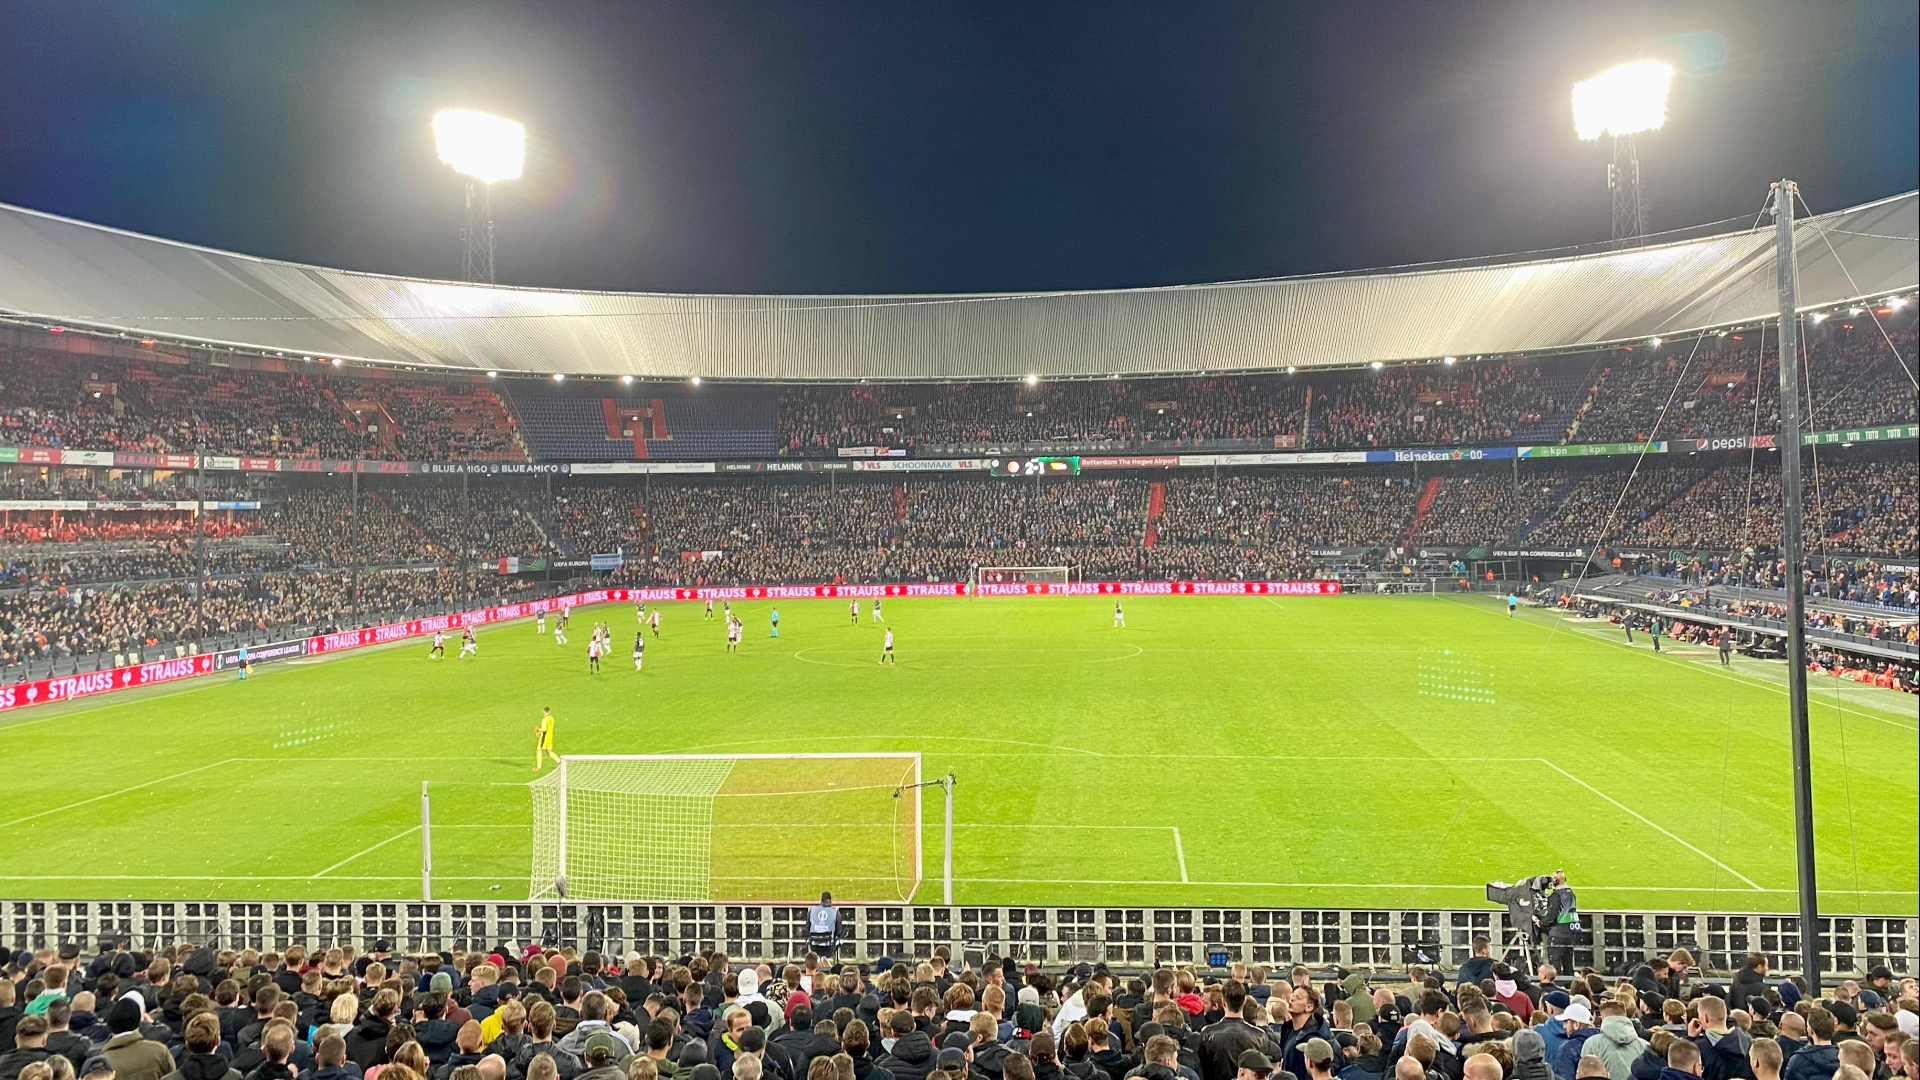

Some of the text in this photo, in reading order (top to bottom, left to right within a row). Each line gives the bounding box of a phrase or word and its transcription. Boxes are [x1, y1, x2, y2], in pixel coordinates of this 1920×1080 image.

[1805, 435, 1818, 444] TOTO
[1826, 434, 1838, 442] TOTO
[1846, 432, 1860, 440] TOTO
[1865, 430, 1878, 440] TOTO
[1887, 429, 1900, 438] TOTO
[1712, 436, 1746, 450] pepsi
[1550, 444, 1644, 456] kpn kpn kpn
[1395, 452, 1449, 462] Heineken
[432, 464, 456, 472] BLUE
[502, 464, 525, 472] BLUE
[697, 588, 746, 598] STRAUSS
[766, 587, 816, 597] STRAUSS
[836, 586, 886, 596] STRAUSS
[906, 585, 956, 596] STRAUSS
[978, 584, 1028, 594] STRAUSS
[1048, 584, 1099, 594] STRAUSS
[1121, 583, 1172, 593] STRAUSS
[1194, 582, 1246, 593] STRAUSS
[1268, 582, 1320, 593] STRAUSS
[584, 590, 608, 604] STRAUSS
[627, 590, 677, 600] STRAUSS
[497, 605, 520, 619] STRAUSS
[420, 617, 449, 632] STRAUSS
[375, 624, 407, 640] STRAUSS
[323, 632, 360, 650] STRAUSS
[226, 654, 238, 664] UEFA
[256, 648, 284, 659] CONFERENCE
[284, 645, 300, 654] LEAGUE
[140, 658, 194, 682] STRAUSS
[48, 672, 113, 699] STRAUSS
